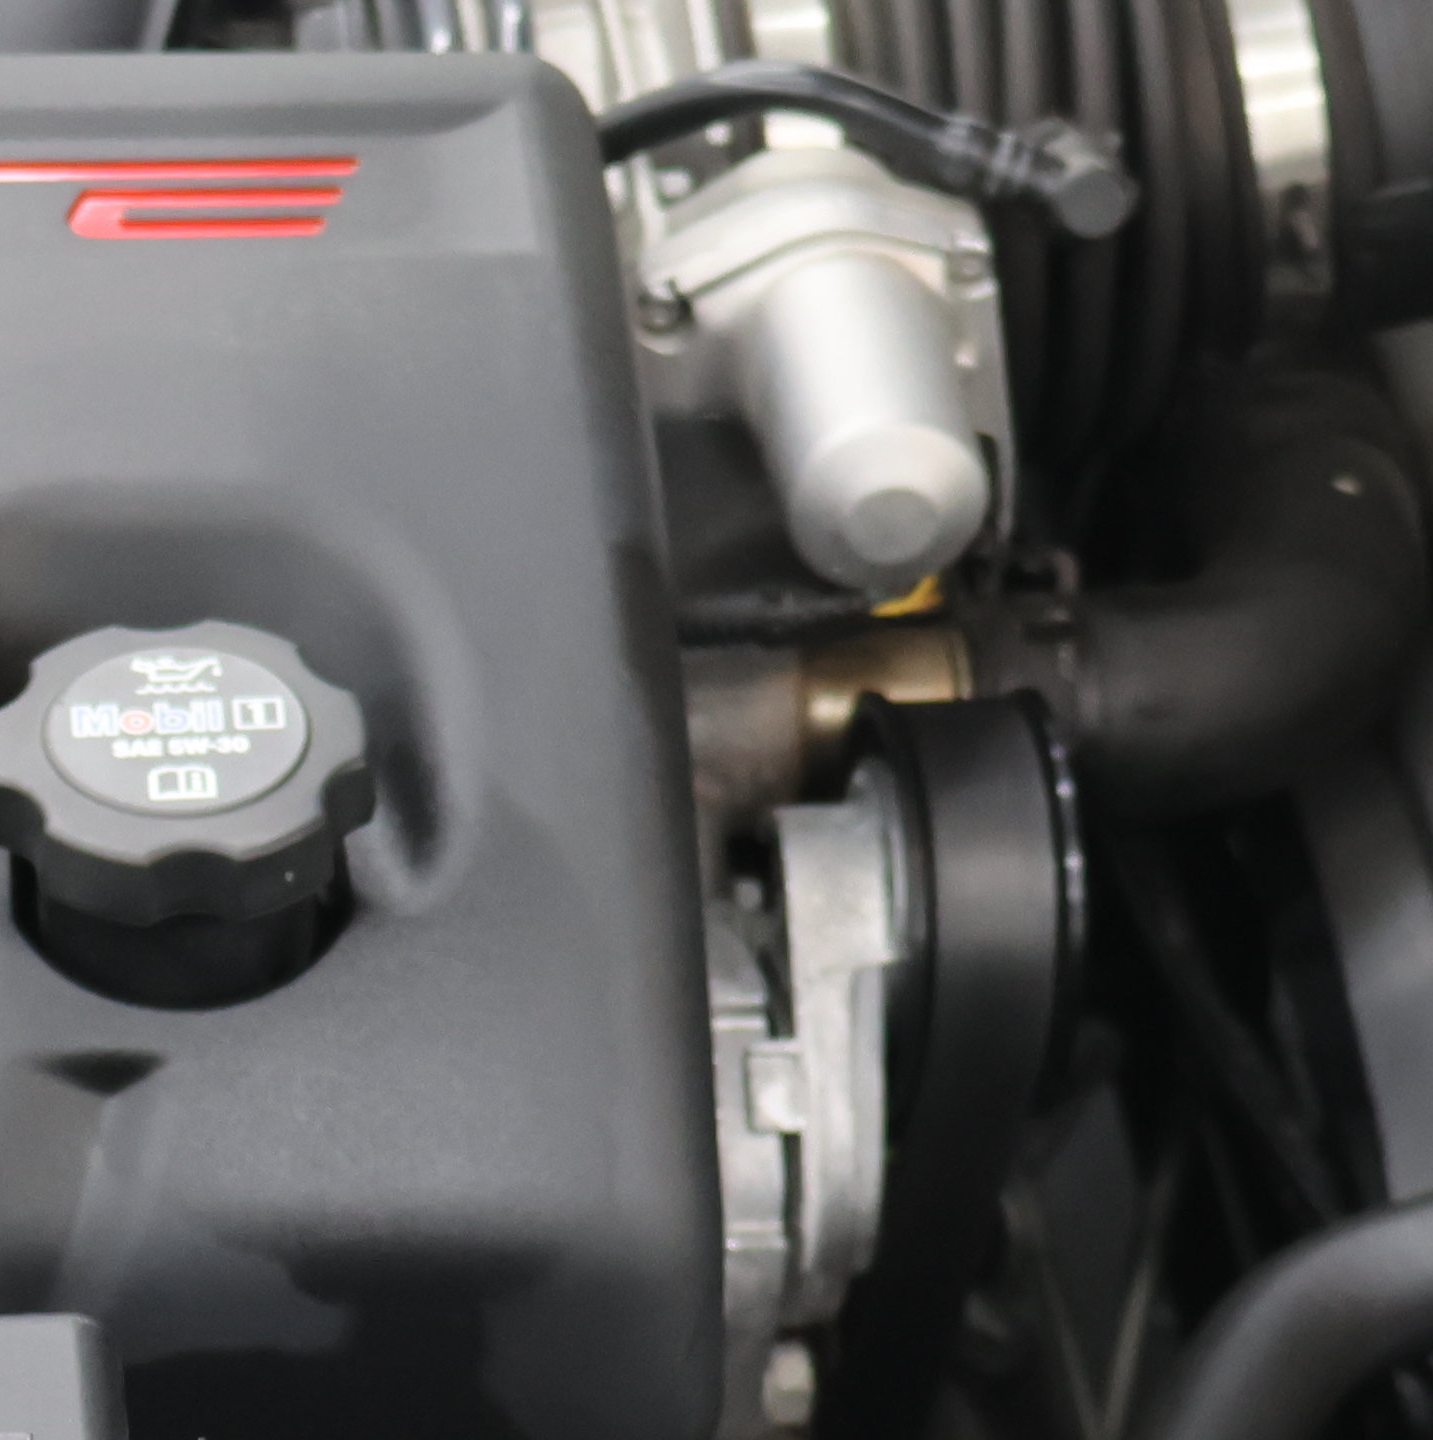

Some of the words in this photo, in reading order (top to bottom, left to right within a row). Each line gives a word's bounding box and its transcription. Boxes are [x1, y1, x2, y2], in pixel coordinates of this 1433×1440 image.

[70, 699, 224, 738] Mobil
[111, 738, 164, 758] SAE
[167, 734, 251, 755] 5W-30
